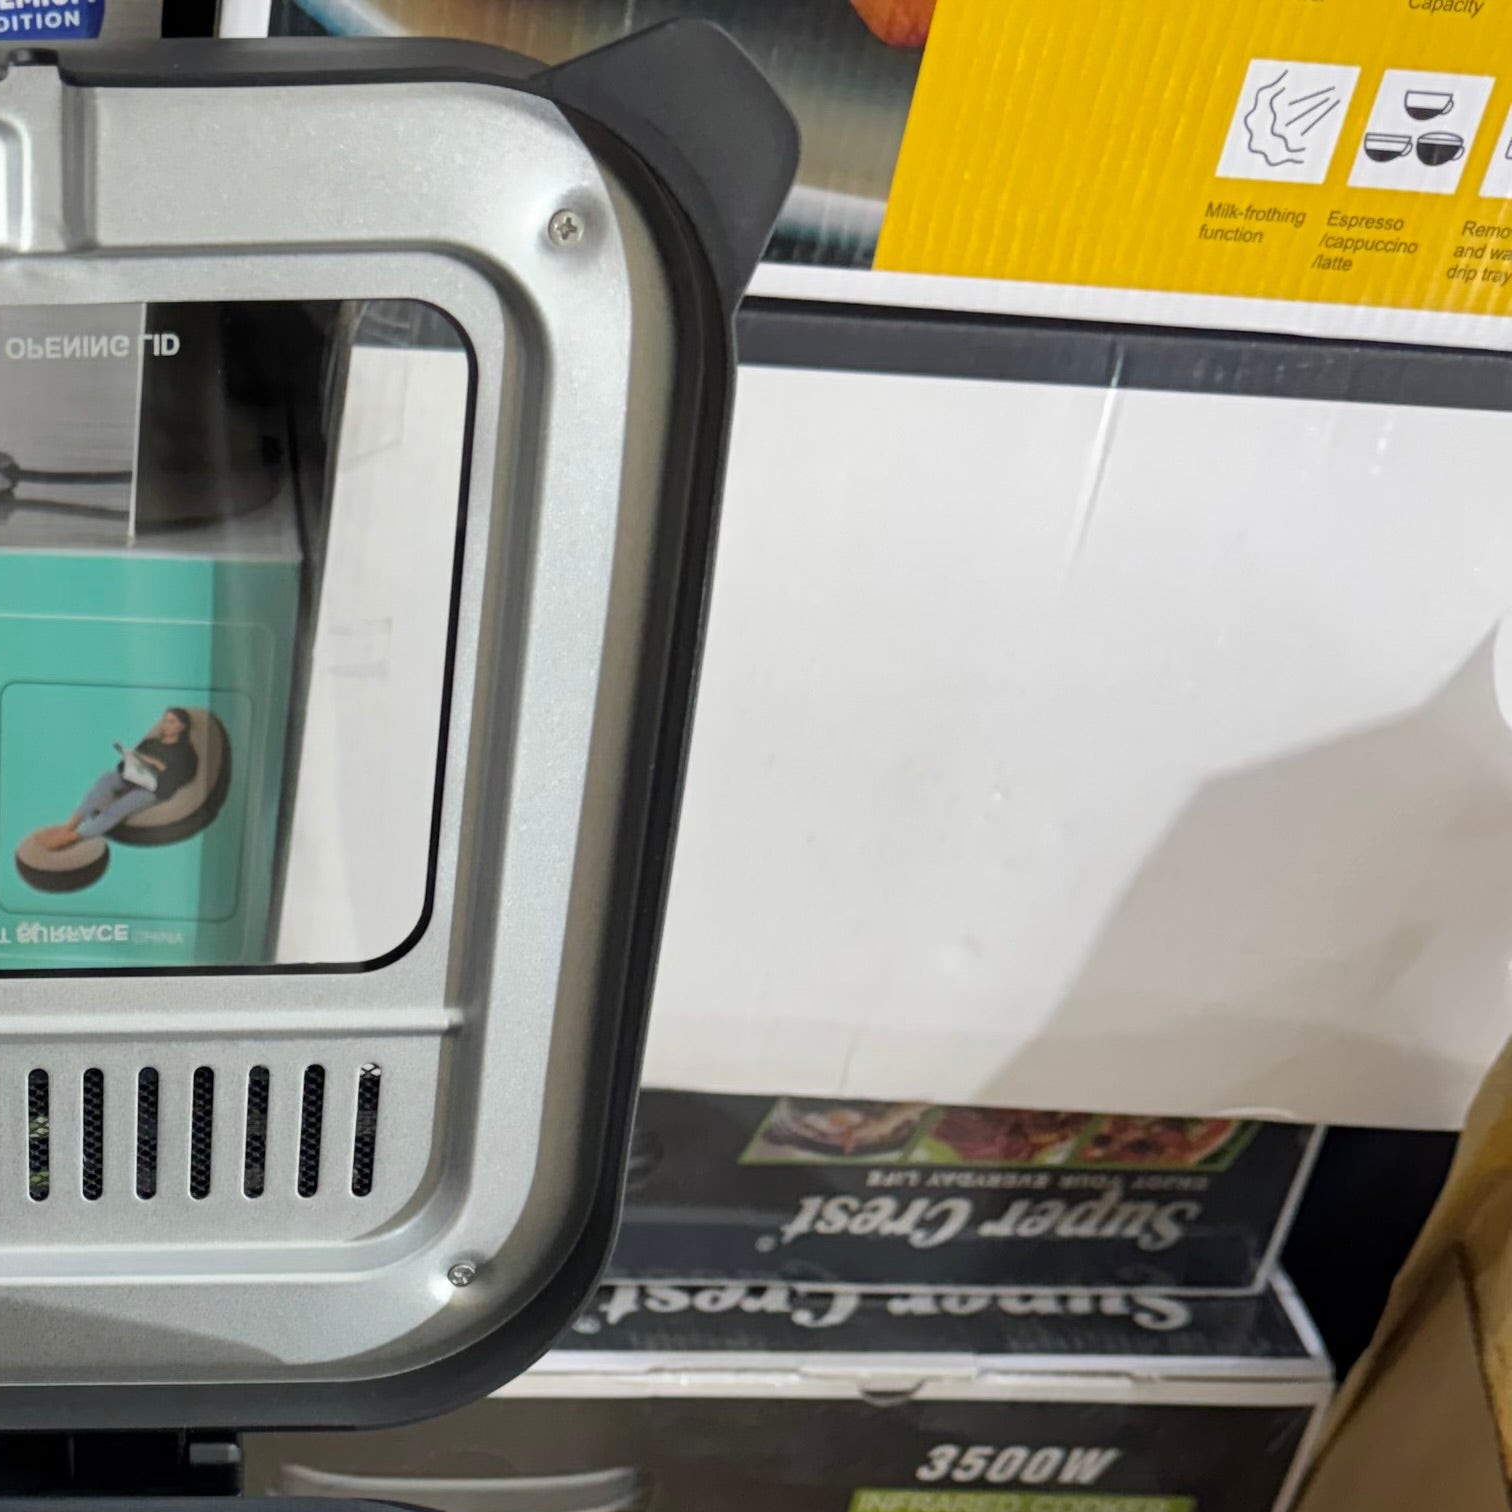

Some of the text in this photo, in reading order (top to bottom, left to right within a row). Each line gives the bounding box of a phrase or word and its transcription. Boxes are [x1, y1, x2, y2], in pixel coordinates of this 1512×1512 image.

[1409, 0, 1484, 18] Capacity
[1204, 202, 1307, 226] Milk-frothing
[1327, 210, 1404, 231] Espresso
[1198, 224, 1264, 243] function
[1319, 233, 1418, 253] /cappuccino
[1453, 244, 1488, 259] and
[1311, 253, 1353, 272] /latte
[1446, 265, 1512, 287] drip tray
[866, 1173, 920, 1188] LIFE
[927, 1173, 1051, 1190] EVERYDAY
[781, 1184, 1202, 1250] Super Crest
[916, 1444, 1122, 1484] 3500W
